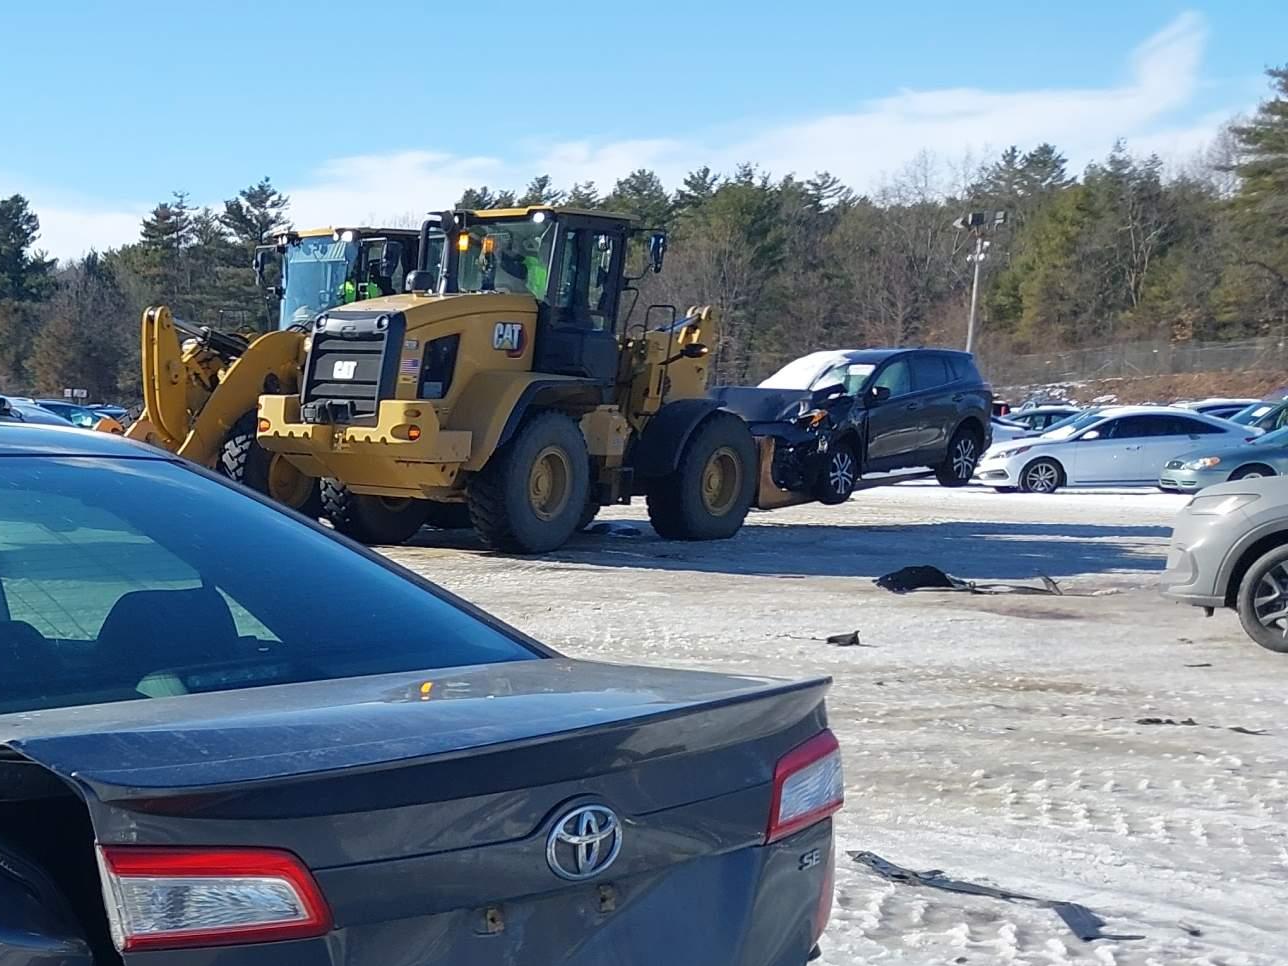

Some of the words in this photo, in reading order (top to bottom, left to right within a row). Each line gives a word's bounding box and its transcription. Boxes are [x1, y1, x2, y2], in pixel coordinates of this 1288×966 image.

[493, 322, 522, 350] CAT
[332, 360, 358, 379] CAT
[800, 849, 821, 870] SE
